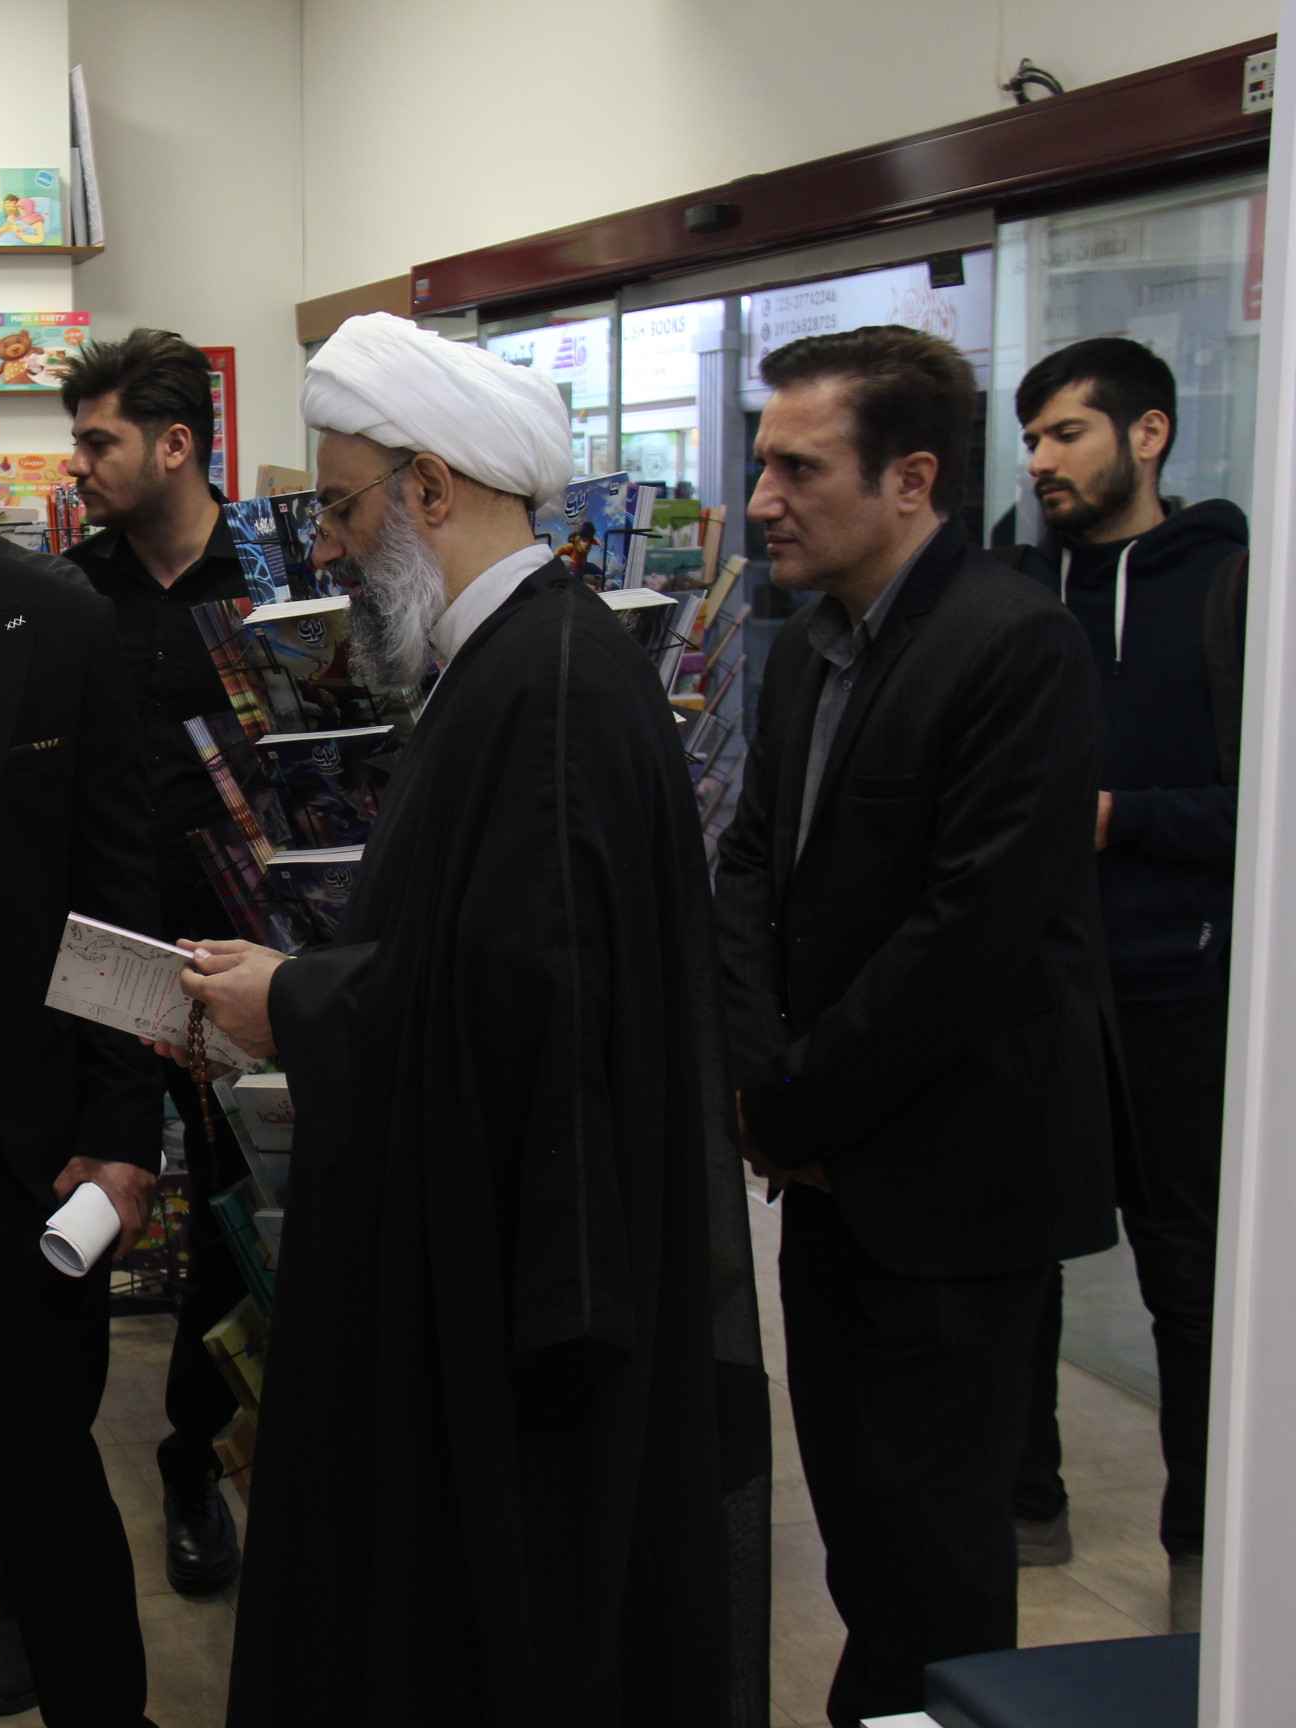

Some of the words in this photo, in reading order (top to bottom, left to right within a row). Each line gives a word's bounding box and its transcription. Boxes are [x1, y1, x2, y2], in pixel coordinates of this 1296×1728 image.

[10, 314, 32, 322] MAKE
[33, 314, 39, 322] A
[40, 314, 66, 322] PARTY
